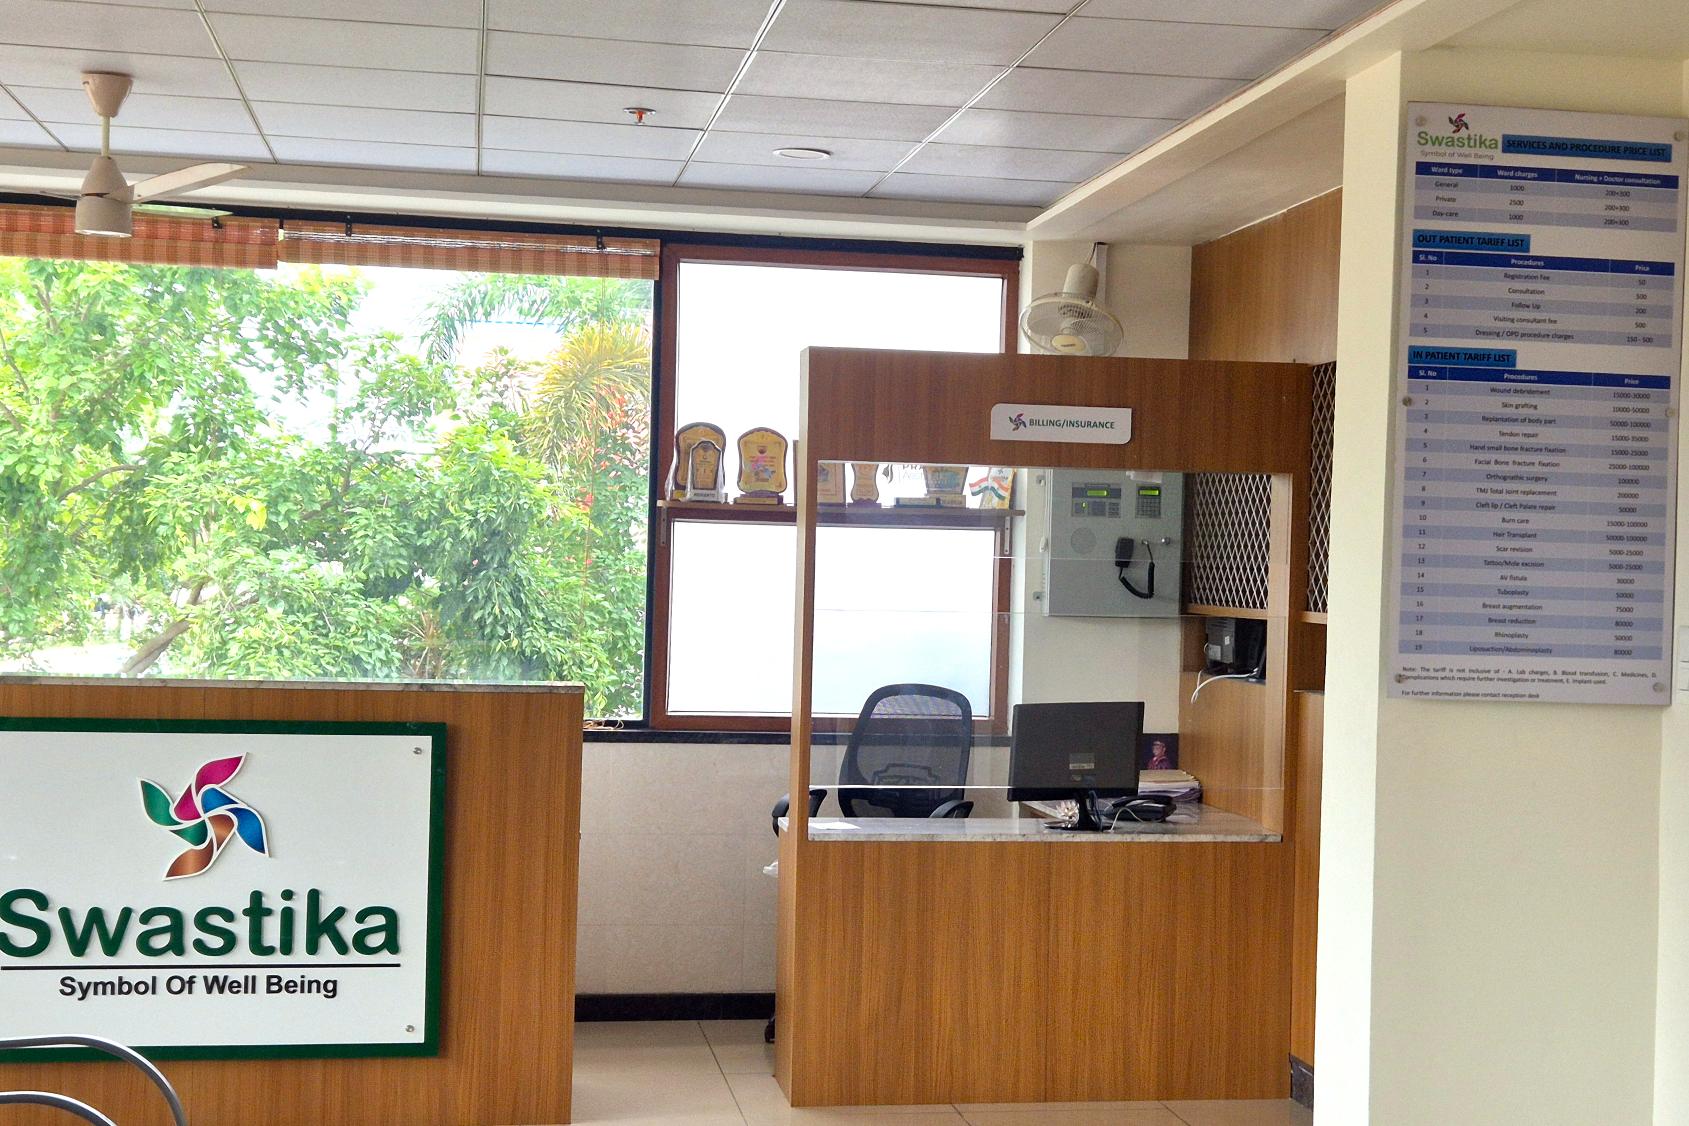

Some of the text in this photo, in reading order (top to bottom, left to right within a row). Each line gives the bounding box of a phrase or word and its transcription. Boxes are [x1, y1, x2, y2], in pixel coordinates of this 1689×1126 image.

[1417, 131, 1498, 150] Swastika
[1507, 140, 1666, 156] SERVICES AND PROCEDURE PRICE LIST
[1515, 170, 1538, 178] charges
[1418, 235, 1524, 247] OUT PATIENT TARIFF LIST
[1476, 330, 1500, 338] Dressing
[1425, 352, 1461, 361] PATIENT
[1464, 353, 1492, 362] TARIFF
[1494, 354, 1511, 362] LIST
[1029, 418, 1115, 429] BILLING/INSURANCE
[1482, 416, 1519, 424] Replantation
[0, 888, 400, 958] Swastika
[60, 974, 338, 1001] Symbol Of Well Being
